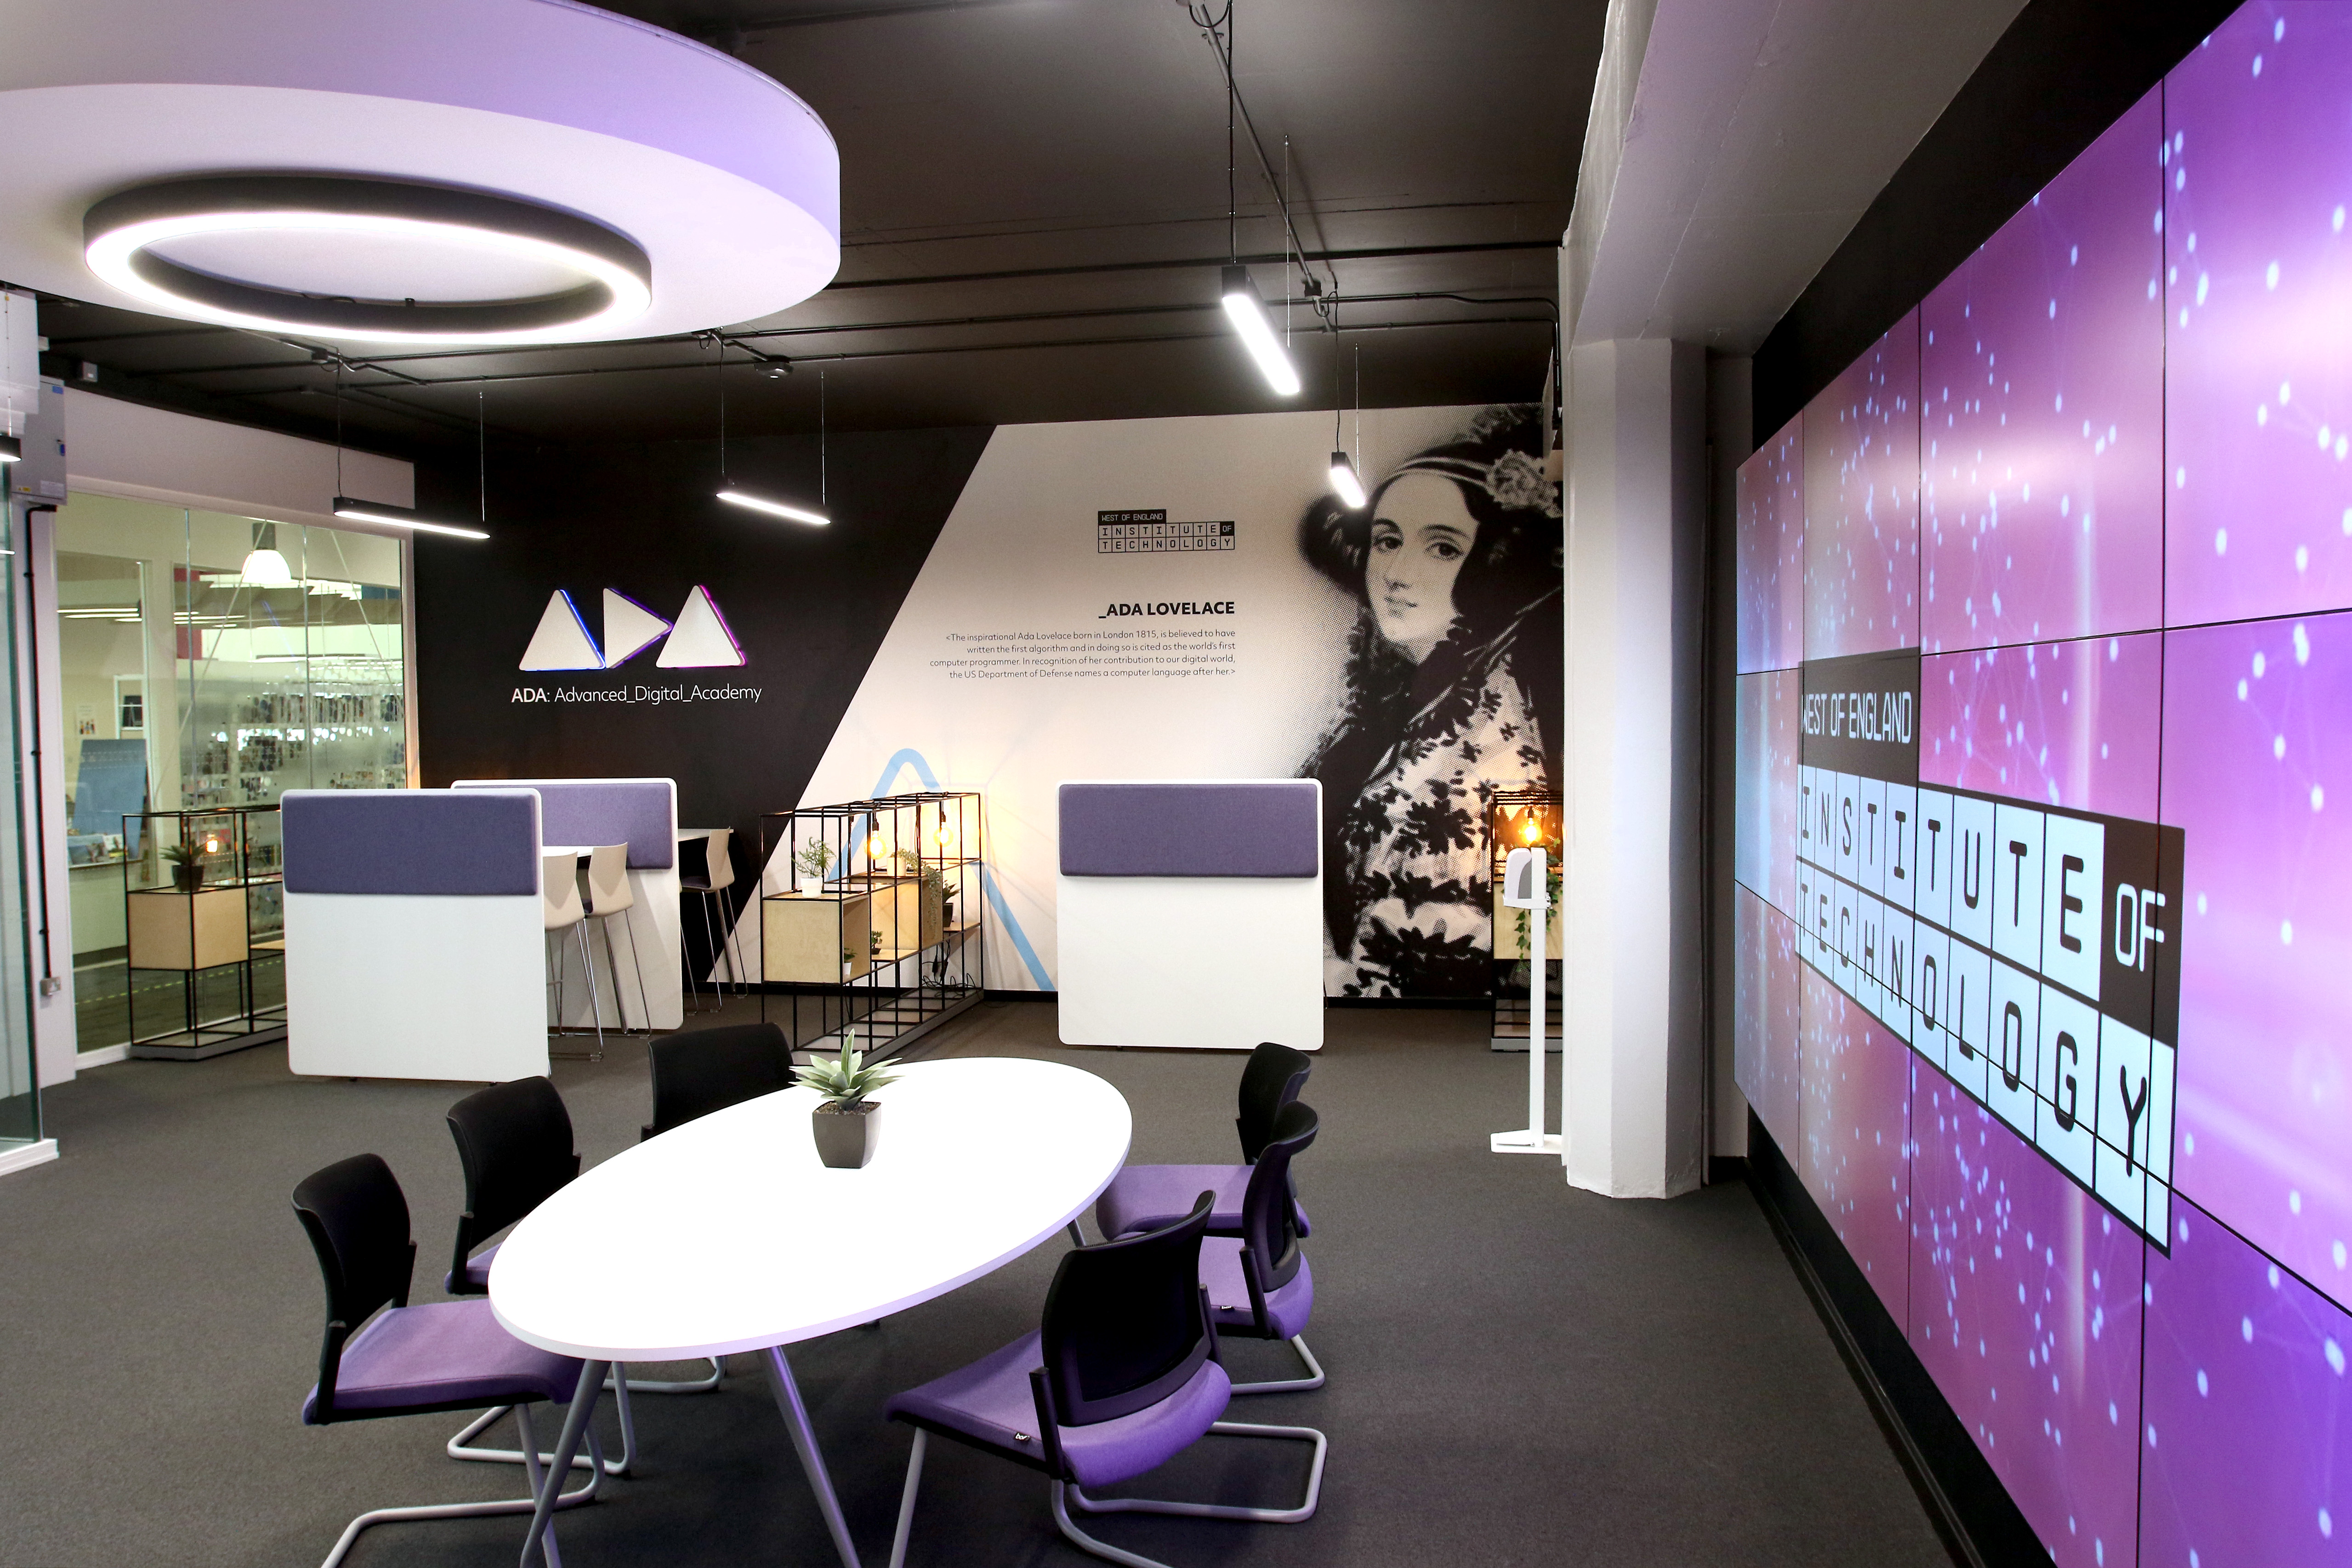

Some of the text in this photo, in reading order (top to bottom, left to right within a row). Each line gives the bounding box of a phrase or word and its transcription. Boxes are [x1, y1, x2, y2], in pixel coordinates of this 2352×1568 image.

[1147, 602, 1235, 615] LOVELACE
[967, 632, 1016, 642] inspirational
[1017, 632, 1034, 640] Ada
[1036, 631, 1072, 640] Lovelace
[1073, 631, 1092, 639] born
[1103, 631, 1134, 639] London
[1136, 630, 1159, 639] 1815,
[1169, 629, 1203, 637] believed
[1216, 629, 1235, 637] have
[1011, 644, 1027, 653] first
[1029, 644, 1068, 654] algorithm
[1070, 643, 1086, 652] and
[1096, 643, 1119, 653] doing
[1140, 642, 1160, 651] cited
[1174, 642, 1187, 650] the
[1219, 641, 1235, 649] first
[930, 659, 968, 668] computer
[970, 659, 1021, 668] programmer.
[1032, 657, 1077, 667] recognition
[1079, 656, 1087, 664] of
[1089, 656, 1102, 664] her
[1104, 655, 1153, 664] contribution
[1182, 654, 1208, 665] digital
[1210, 654, 1235, 663] world,
[964, 670, 976, 678] US
[978, 670, 1028, 680] Department
[1029, 669, 1038, 677] of
[1040, 669, 1073, 677] Defense
[1110, 670, 1150, 678] computer
[1152, 668, 1191, 678] language
[1193, 667, 1214, 675] after
[511, 687, 550, 703] ADA:
[1801, 691, 1912, 744] WEST OF ENGLAND
[1802, 785, 2166, 972] INSTITUTE OF
[1801, 883, 2148, 1178] TECHNOLOGY
